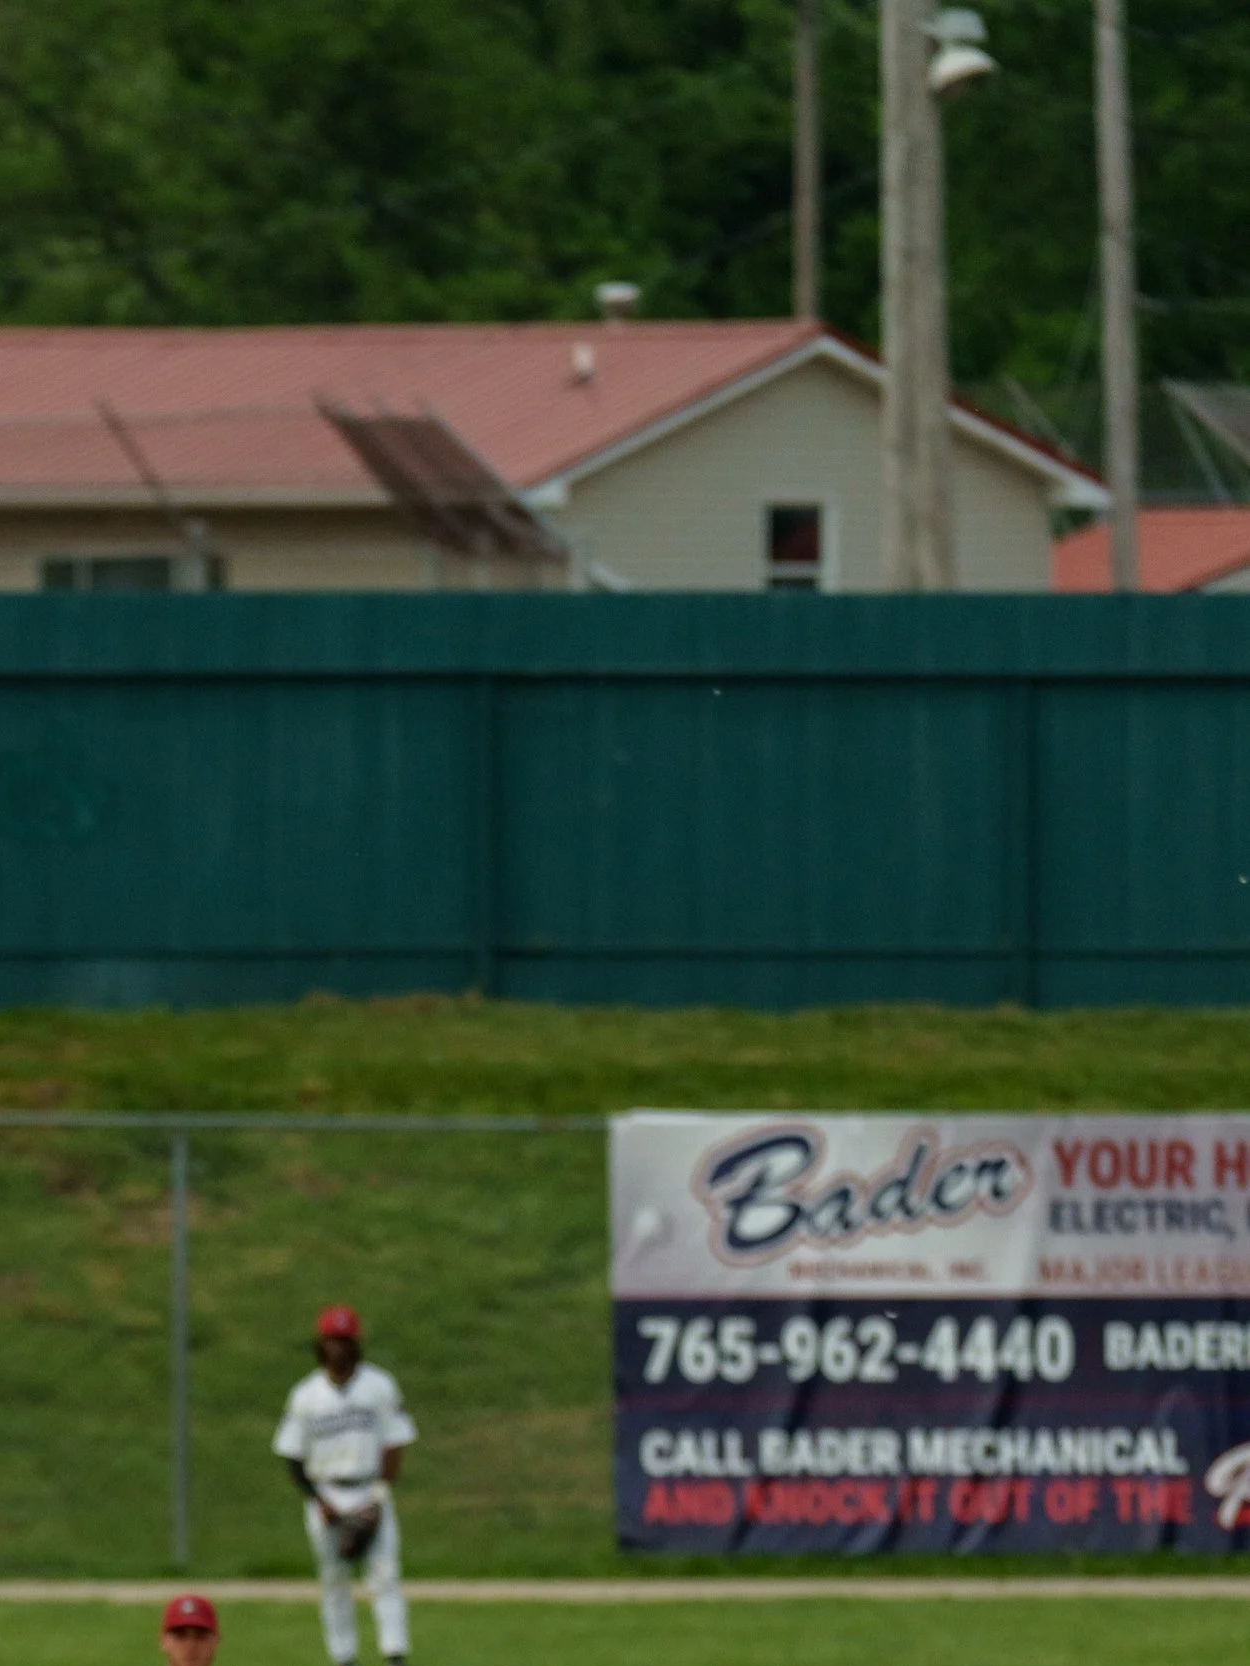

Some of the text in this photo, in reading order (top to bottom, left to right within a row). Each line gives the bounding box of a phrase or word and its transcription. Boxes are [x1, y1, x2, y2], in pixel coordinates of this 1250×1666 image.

[1054, 1138, 1196, 1190] YOUR
[705, 1134, 1012, 1250] Bader
[1050, 1198, 1236, 1243] ELECTRIC,
[636, 1314, 1076, 1384] 765-962-4440
[1102, 1319, 1250, 1371] BADER
[640, 1427, 1188, 1477] CALL BADER MECHANICAL
[643, 1480, 735, 1525] AND
[744, 1480, 890, 1525] KNOCK
[898, 1480, 937, 1524] IT
[950, 1480, 1031, 1524] OUT
[1045, 1480, 1097, 1524] OF
[1112, 1480, 1191, 1525] THE
